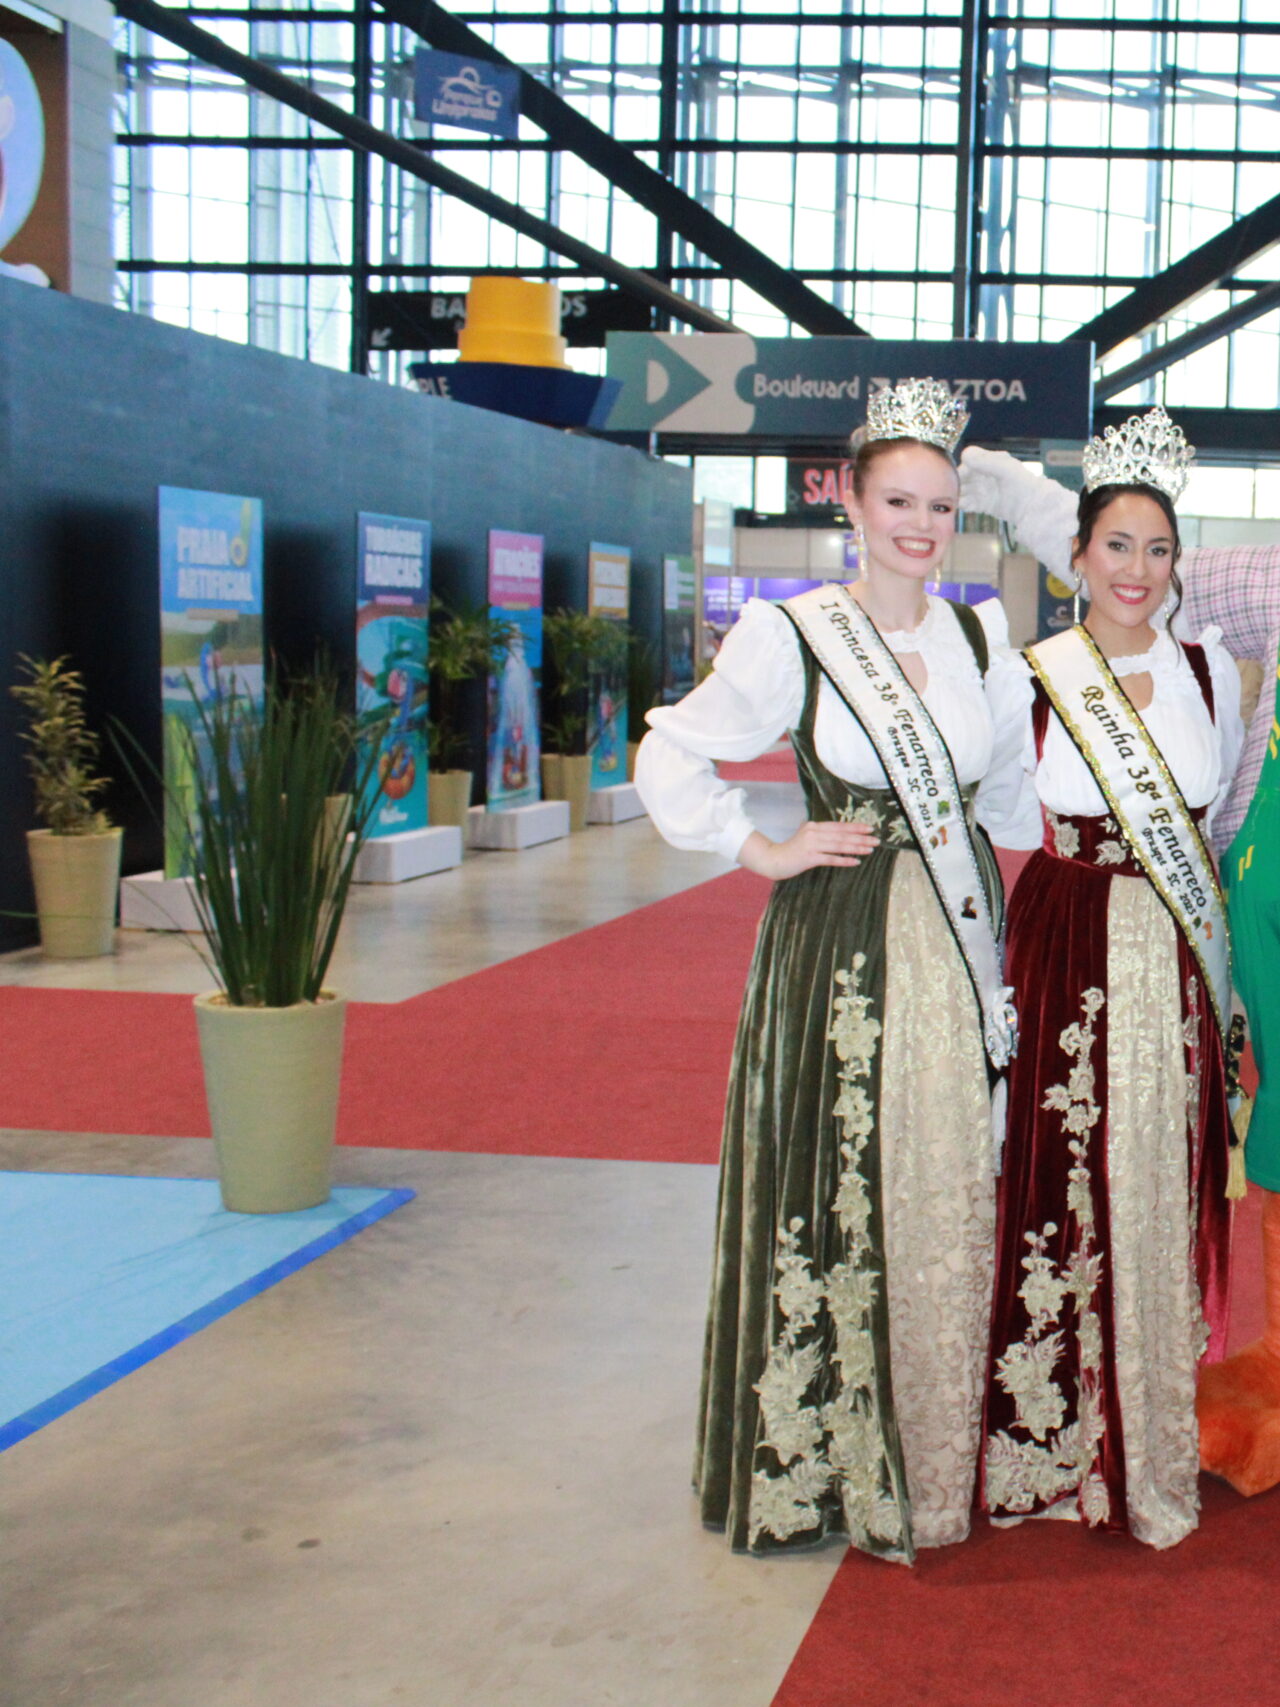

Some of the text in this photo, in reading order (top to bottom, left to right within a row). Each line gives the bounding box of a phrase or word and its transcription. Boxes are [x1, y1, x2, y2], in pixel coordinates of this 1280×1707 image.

[753, 373, 860, 399] Boulevard
[177, 526, 230, 565] PRAIA
[177, 567, 254, 601] ARTIFICIAL
[829, 612, 880, 679] Princesa
[893, 708, 939, 797] Fenarreco
[908, 777, 921, 793] SC
[1081, 686, 1134, 759] Rainha
[1148, 807, 1207, 908] Fenarreco
[1167, 872, 1182, 888] SC
